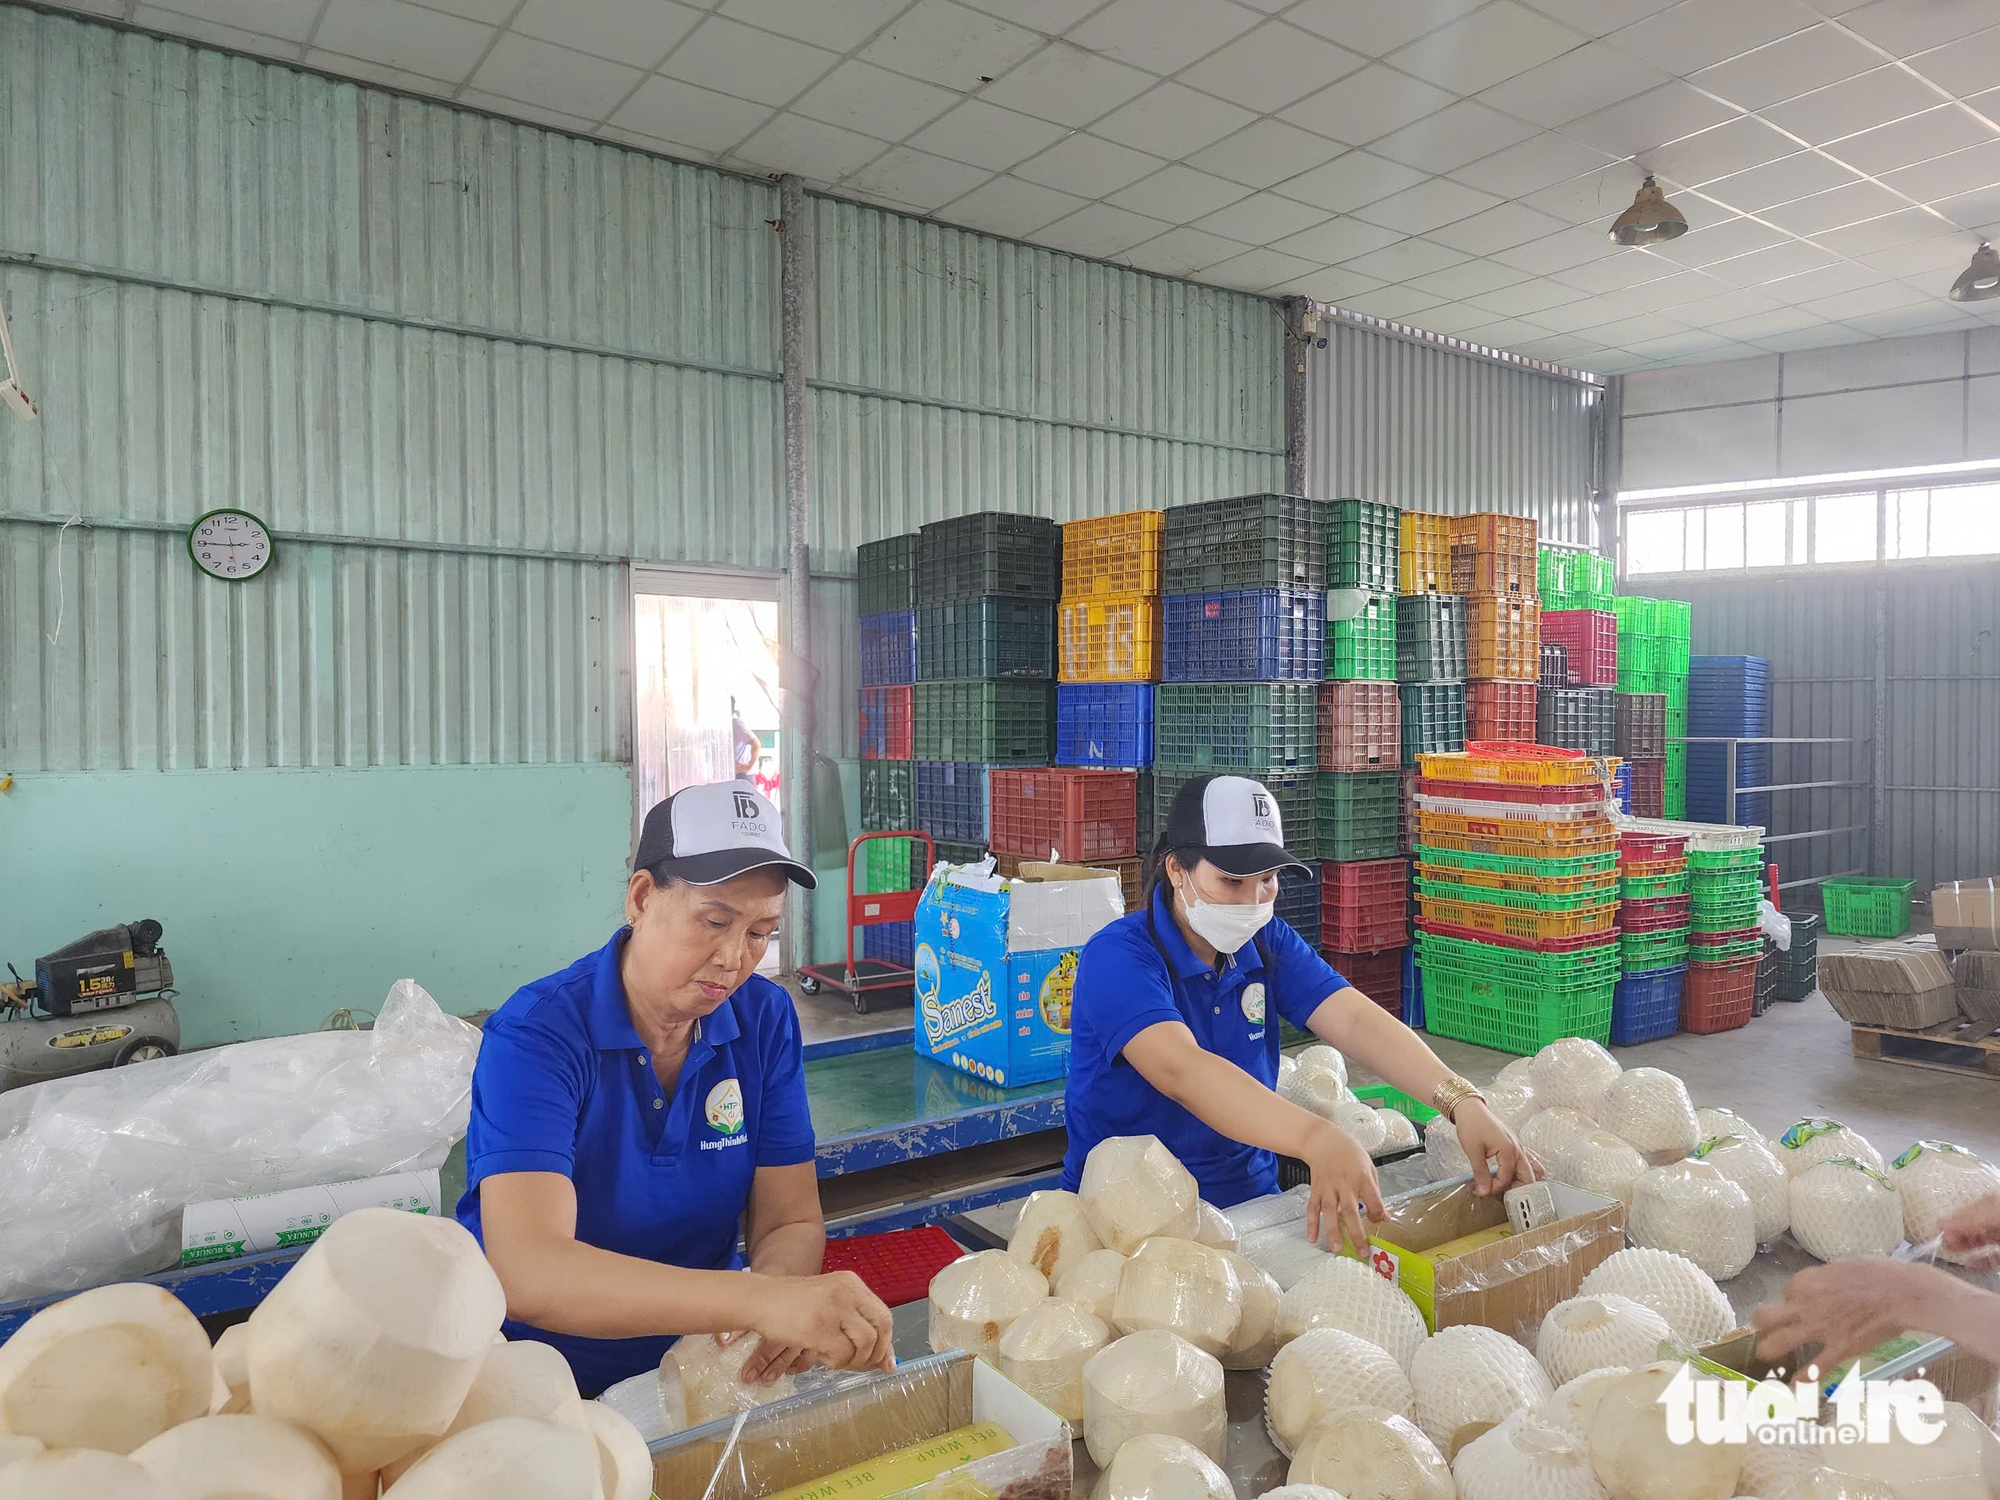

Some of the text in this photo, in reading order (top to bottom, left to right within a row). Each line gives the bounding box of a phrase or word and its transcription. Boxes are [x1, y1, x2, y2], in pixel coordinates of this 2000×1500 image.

[212, 519, 221, 527] 11
[224, 516, 237, 524] 12
[201, 528, 213, 536] 10
[251, 530, 261, 538] 2
[732, 821, 767, 832] FADO
[1471, 910, 1496, 920] THANH
[1474, 919, 1494, 929] DANH
[79, 977, 101, 992] 1.5
[922, 982, 994, 1040] Sanest
[916, 1428, 997, 1463] BEE WRAP
[842, 1471, 876, 1489] BEE
